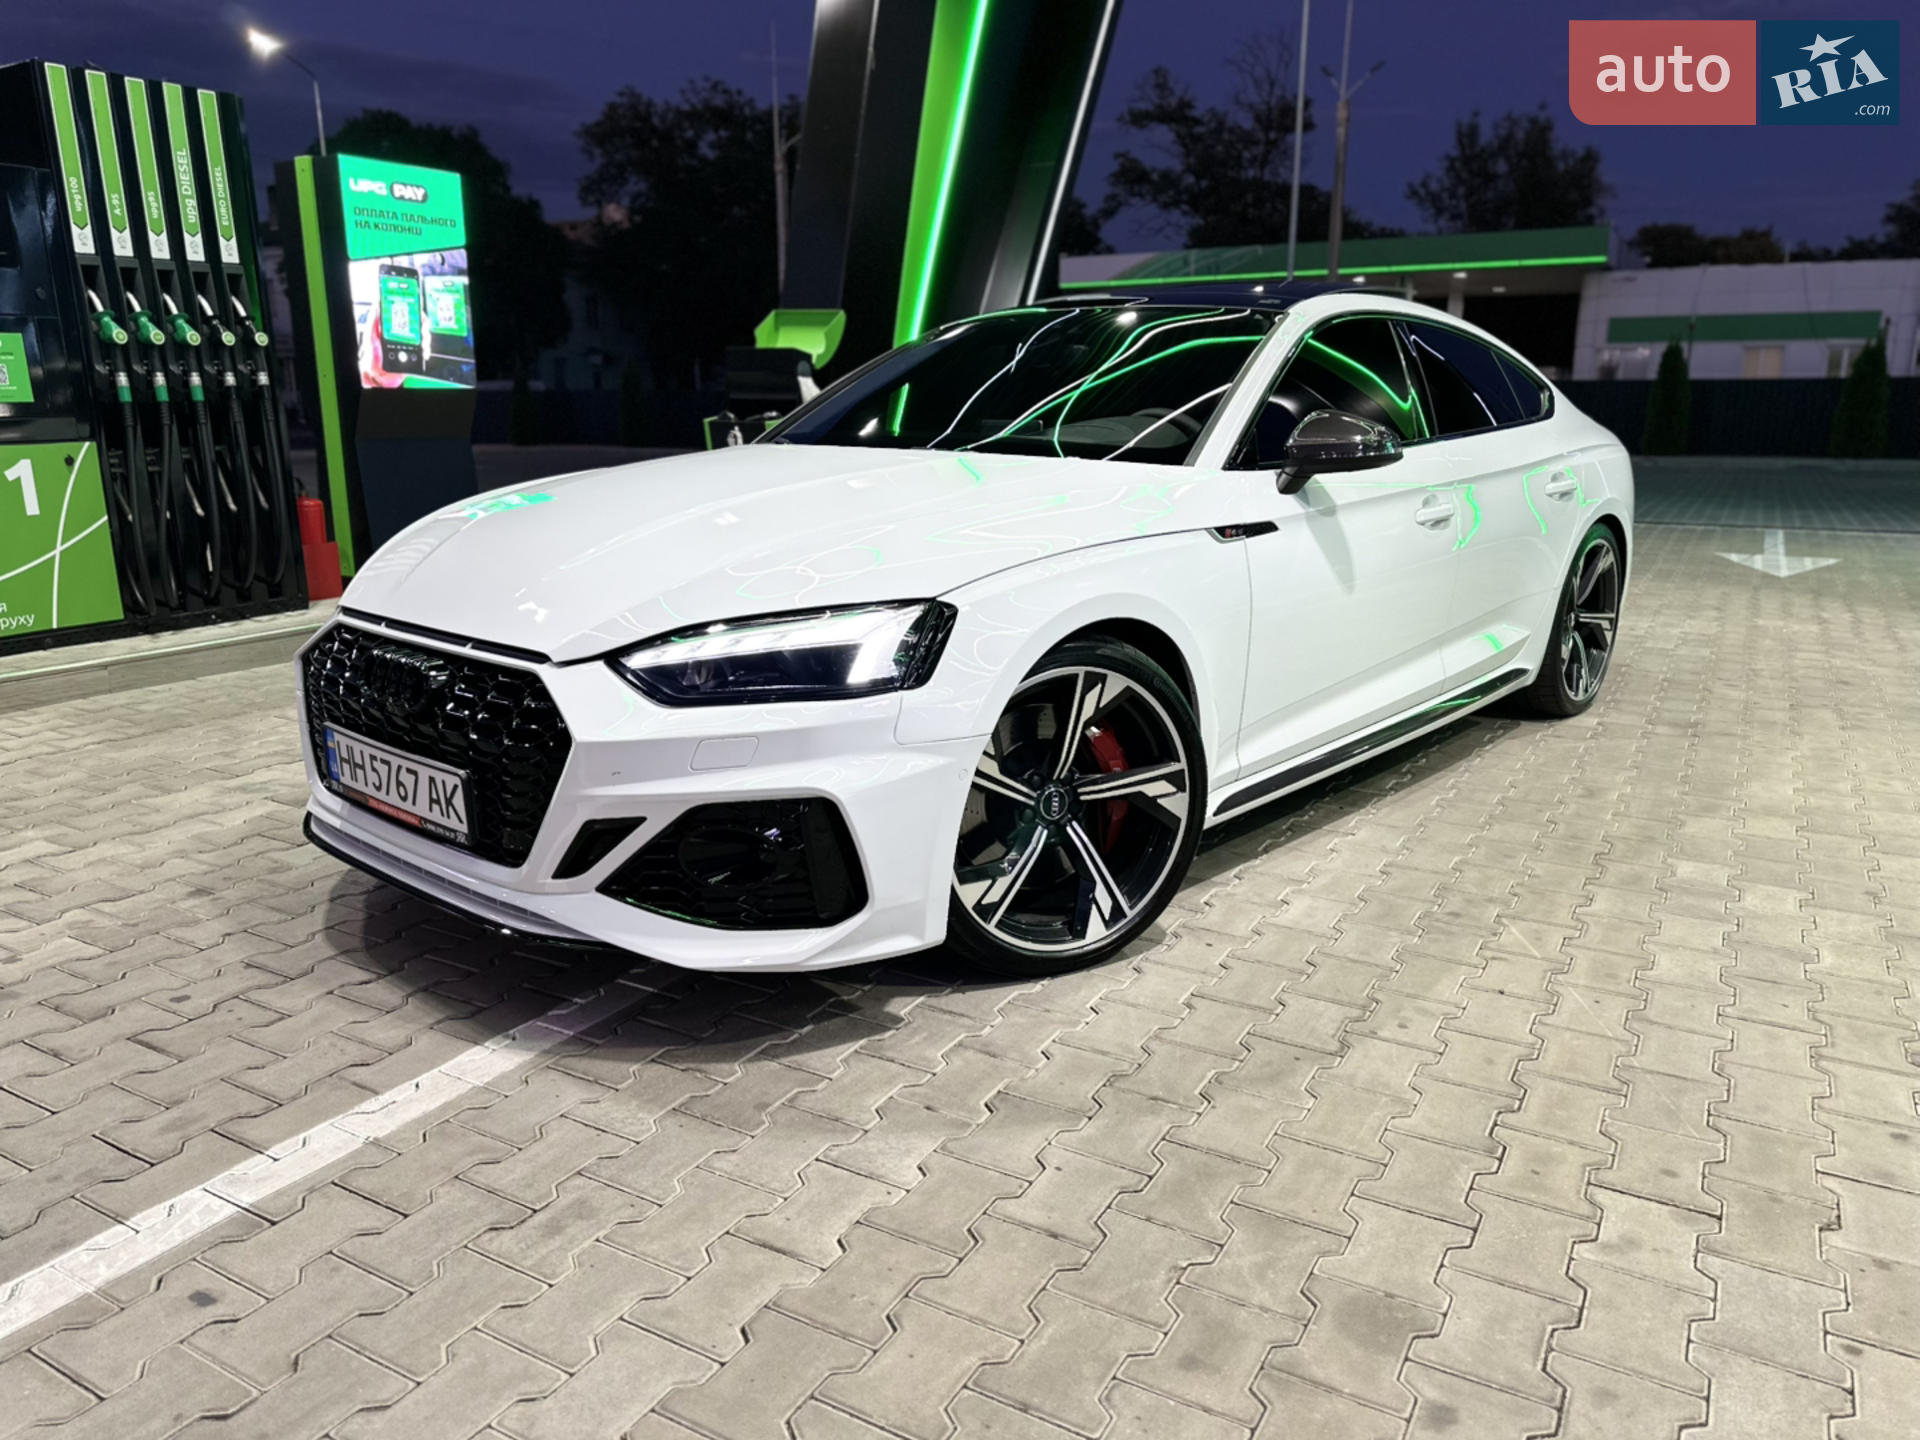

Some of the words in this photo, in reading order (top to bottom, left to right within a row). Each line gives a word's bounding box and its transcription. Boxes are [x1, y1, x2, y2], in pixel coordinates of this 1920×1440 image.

[176, 148, 192, 195] DIESEL
[214, 165, 225, 198] DIESEL
[69, 176, 83, 212] upg100
[349, 177, 387, 196] UPG
[392, 182, 426, 201] PAY
[111, 193, 122, 216] A-95
[147, 191, 159, 219] upg95
[185, 198, 198, 224] upg
[219, 199, 230, 226] EURO
[354, 206, 399, 221] ОПЛАТА
[401, 212, 457, 228] ПАЛЬНОГО
[355, 219, 371, 230] НА
[3, 458, 41, 516] 1
[368, 753, 419, 807] 5767
[428, 774, 464, 825] AK
